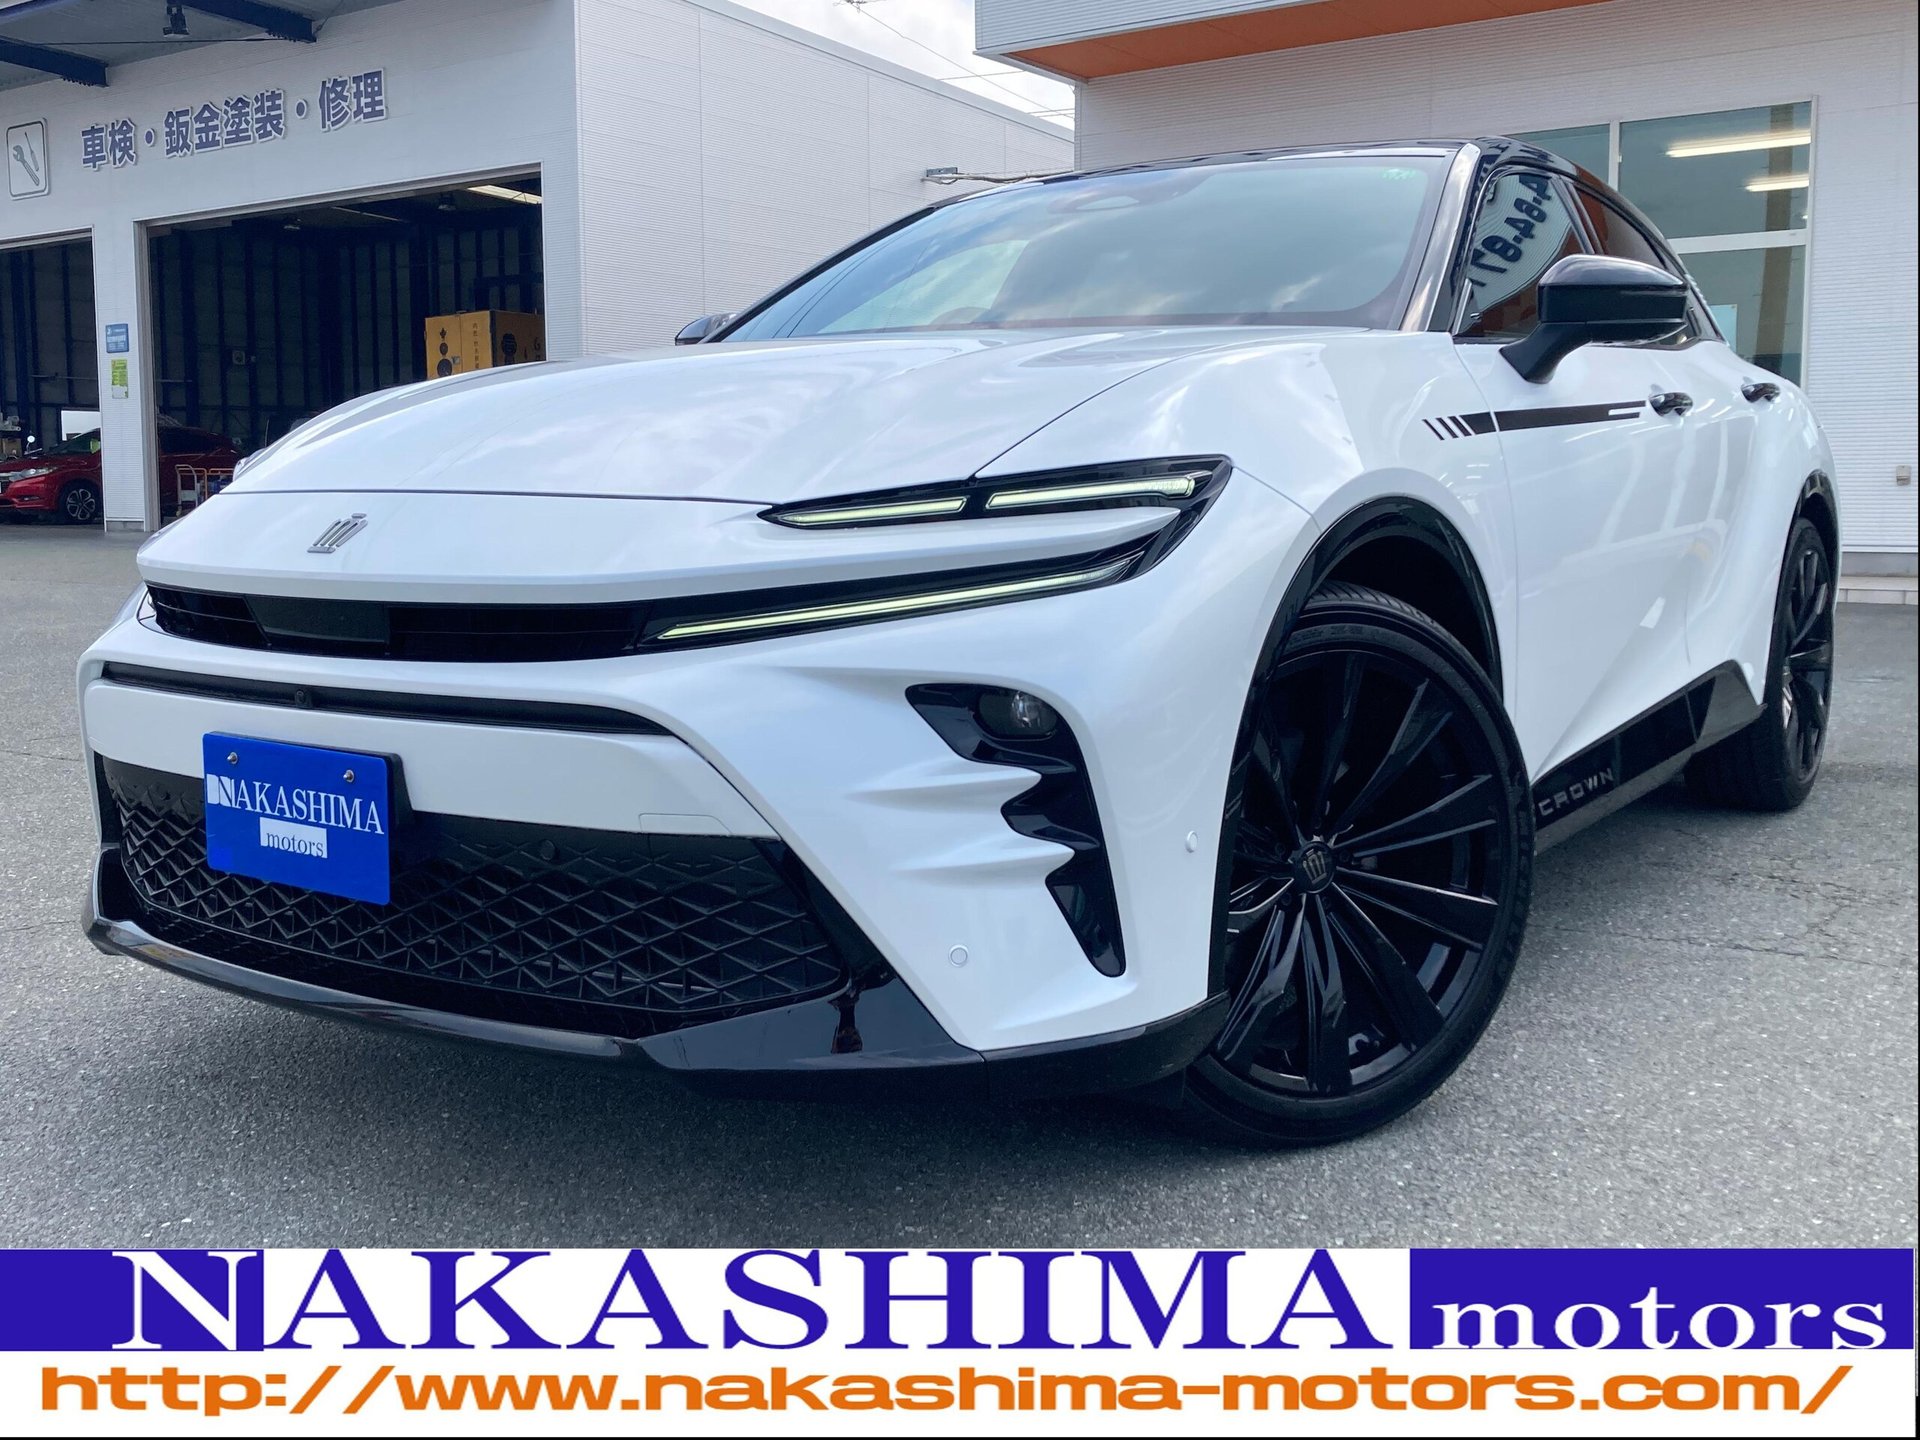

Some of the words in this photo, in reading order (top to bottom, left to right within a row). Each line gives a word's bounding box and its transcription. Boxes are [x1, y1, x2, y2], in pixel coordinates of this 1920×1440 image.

[81, 69, 387, 171] 車検・鈑金塗装・修理
[212, 775, 384, 835] NAKASHIMA
[1538, 767, 1614, 816] CROWN
[266, 832, 324, 858] motors
